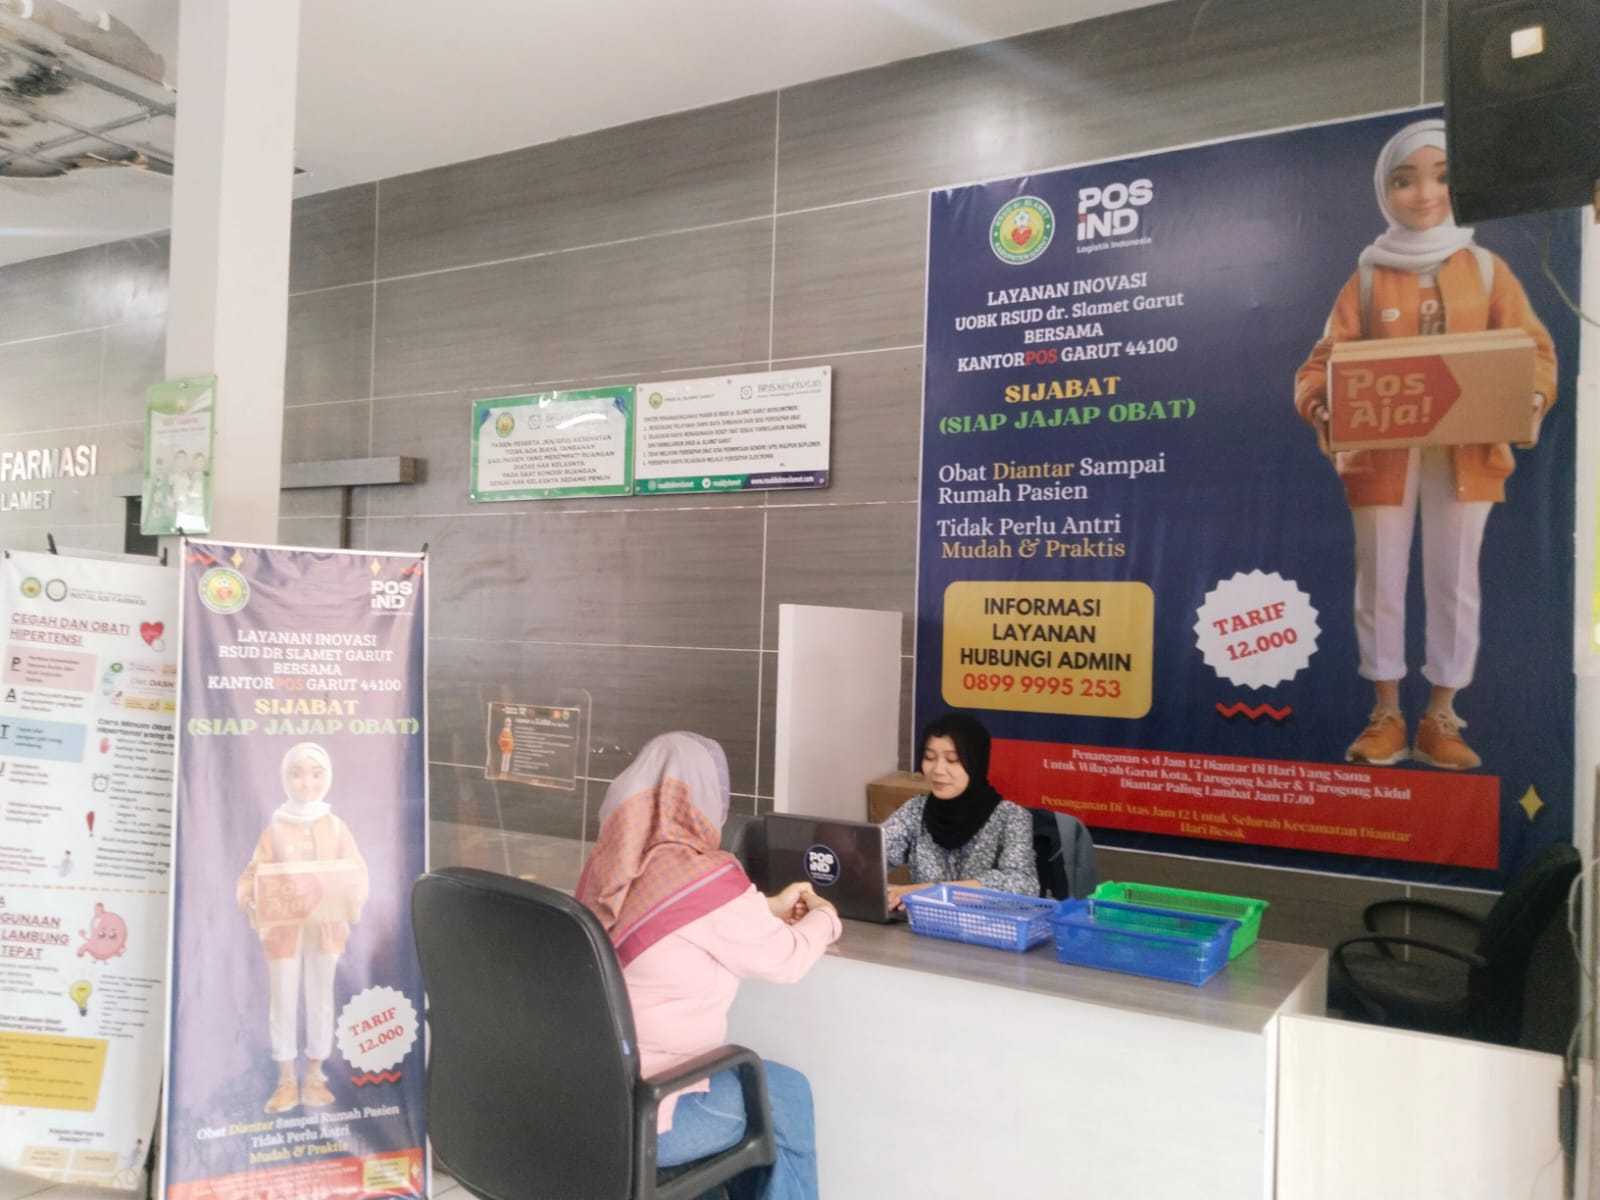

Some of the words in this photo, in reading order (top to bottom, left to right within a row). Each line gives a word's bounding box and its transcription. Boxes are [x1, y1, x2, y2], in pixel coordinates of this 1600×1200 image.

[1078, 179, 1153, 214] POS
[987, 283, 1069, 306] LAYANAN
[1073, 272, 1148, 296] INOVASI
[955, 310, 997, 331] UOBK
[1001, 307, 1043, 325] RSUD
[1046, 306, 1069, 320] dr.
[1072, 298, 1129, 318] Slamet
[1132, 292, 1184, 311] Garut
[1024, 323, 1104, 344] BERSAMA
[1061, 342, 1121, 362] GARUT
[1125, 336, 1178, 356] 44100
[1004, 376, 1121, 403] SIJABAT
[1340, 368, 1425, 399] Pos
[939, 414, 1007, 434] (SIAP
[1014, 406, 1100, 430] JAJAP
[1108, 398, 1196, 423] OBAT)
[1350, 395, 1433, 432] Aja!
[0, 445, 97, 482] FARMASI
[939, 463, 987, 483] Obat
[992, 460, 1075, 481] Diantar
[1080, 452, 1165, 479] Sampai
[938, 483, 1011, 505] Rumah
[1016, 481, 1088, 502] Pasien
[937, 517, 994, 537] Tidak
[999, 515, 1056, 536] Perlu
[1061, 513, 1121, 534] Antri
[941, 539, 1012, 559] Mudah
[1018, 537, 1041, 558] &
[1045, 537, 1125, 558] Praktis
[371, 580, 412, 595] POS
[984, 597, 1101, 617] INFORMASI
[1213, 601, 1286, 636] TARIF
[12, 612, 58, 627] CEGAH
[59, 616, 88, 631] DAN
[91, 620, 130, 636] OBATI
[992, 623, 1096, 643] LAYANAN
[9, 629, 83, 646] HIPERTENSI
[238, 630, 314, 645] LAYANAN
[316, 633, 377, 647] INOVASI
[1225, 627, 1298, 661] 12.000
[11, 657, 21, 668] P
[218, 646, 261, 659] RSUD
[263, 646, 283, 659] DR
[285, 648, 344, 661] SLAMET
[345, 650, 393, 662] GARUT
[960, 648, 1051, 668] HUBUNGI
[1057, 651, 1131, 671] ADMIN
[273, 662, 343, 676] BERSAMA
[6, 688, 16, 700] A
[306, 678, 358, 691] GARUT
[360, 679, 402, 691] 44100
[963, 672, 1015, 691] 0899
[1020, 676, 1073, 696] 9995
[1080, 679, 1121, 698] 253
[254, 699, 360, 716] SIJABAT
[187, 717, 257, 736] (SIAP
[264, 718, 343, 736] JAJAP
[349, 718, 420, 736] OBAT)
[1072, 749, 1140, 764] Penanganan
[1161, 756, 1186, 768] Jam
[1188, 759, 1200, 769] 12
[1203, 760, 1249, 773] Diantar
[1251, 763, 1265, 773] Di
[1267, 764, 1296, 777] Hari
[1299, 767, 1331, 780] Yang
[1333, 769, 1371, 783] Sama
[1043, 758, 1075, 771] Untuk
[1078, 762, 1124, 776] Wilayah
[1125, 766, 1158, 778] Garut
[1373, 786, 1411, 800] Kidul
[1120, 778, 1163, 791] Diantar
[1165, 782, 1203, 797] Paling
[1253, 790, 1281, 802] Jam
[2, 929, 70, 946] LAMBUNG
[2, 945, 44, 960] TEPAT
[350, 1007, 397, 1037] TARIF
[359, 1025, 405, 1054] 12.000
[252, 1134, 285, 1148] Tidak
[287, 1130, 318, 1143] Perlu
